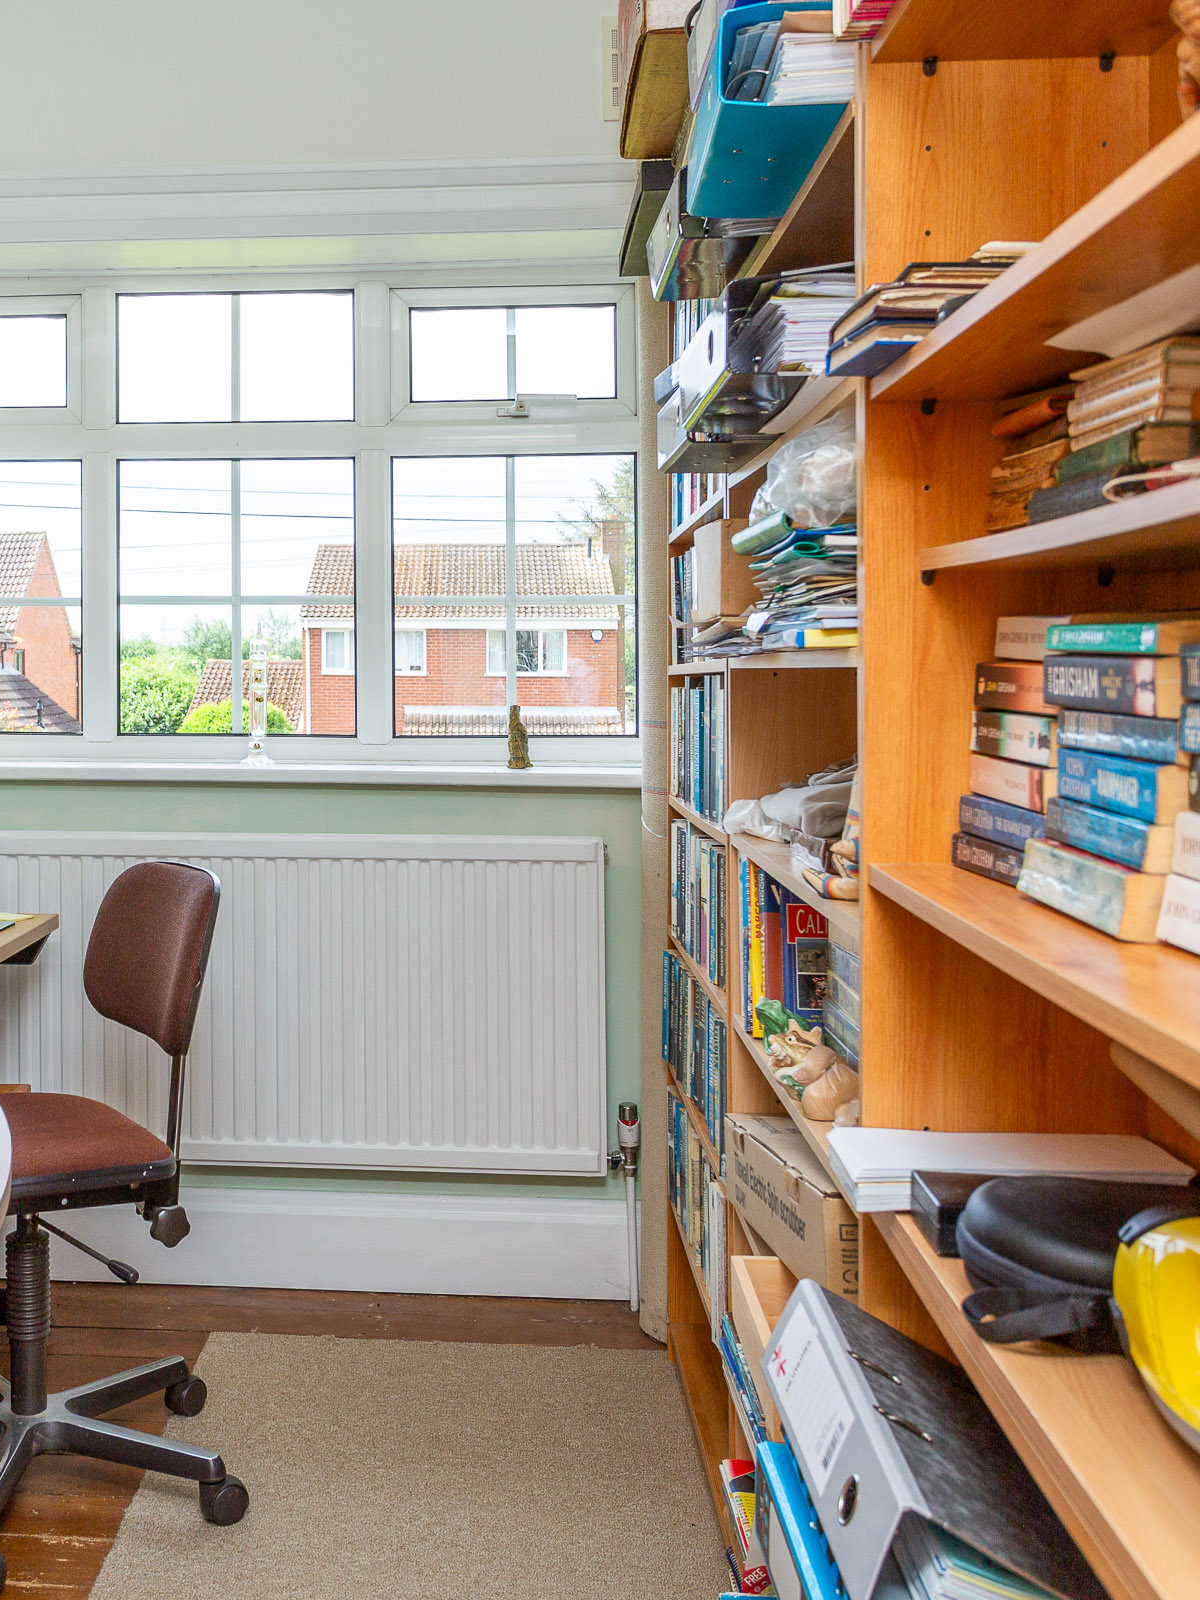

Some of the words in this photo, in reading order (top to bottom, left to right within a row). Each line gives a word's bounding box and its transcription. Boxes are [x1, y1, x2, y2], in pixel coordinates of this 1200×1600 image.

[1053, 666, 1099, 699] GRISHAM
[1066, 757, 1084, 776] JOHN
[1060, 776, 1091, 801] GRISHAM
[796, 908, 829, 934] CALI
[750, 1165, 767, 1205] Electric
[767, 1182, 780, 1218] Spin
[744, 1567, 767, 1587] FREE
